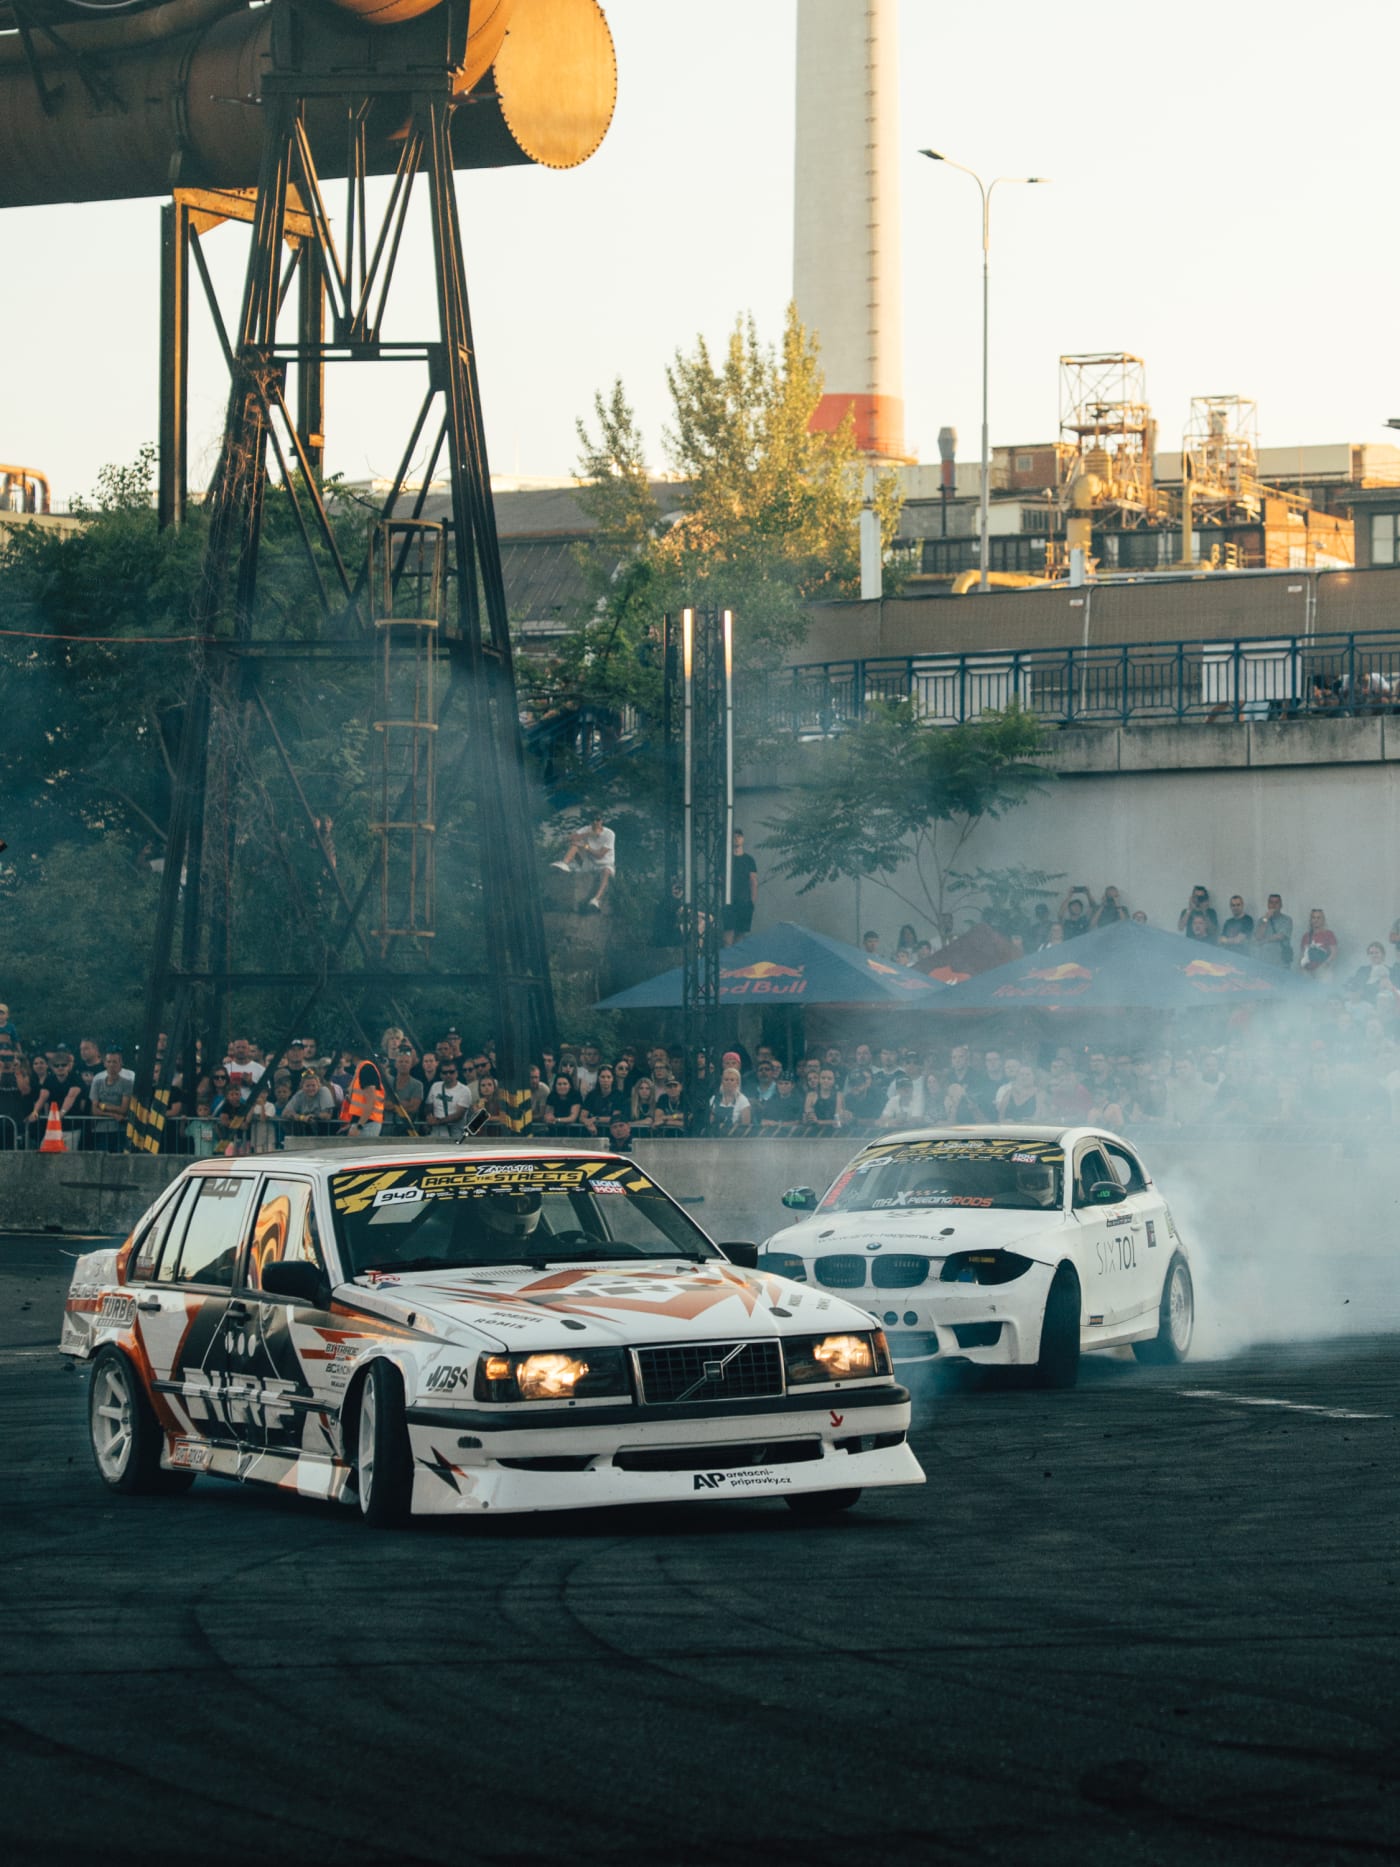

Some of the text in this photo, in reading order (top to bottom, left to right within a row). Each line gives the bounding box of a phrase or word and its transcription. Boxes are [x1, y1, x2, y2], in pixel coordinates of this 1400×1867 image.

[751, 979, 808, 994] Bull
[425, 1175, 474, 1186] RACE
[493, 1171, 578, 1183] STREETS
[380, 1190, 418, 1202] 940
[593, 1186, 626, 1195] MOLY
[1096, 1235, 1137, 1275] SIXTOL
[693, 1472, 726, 1490] AP
